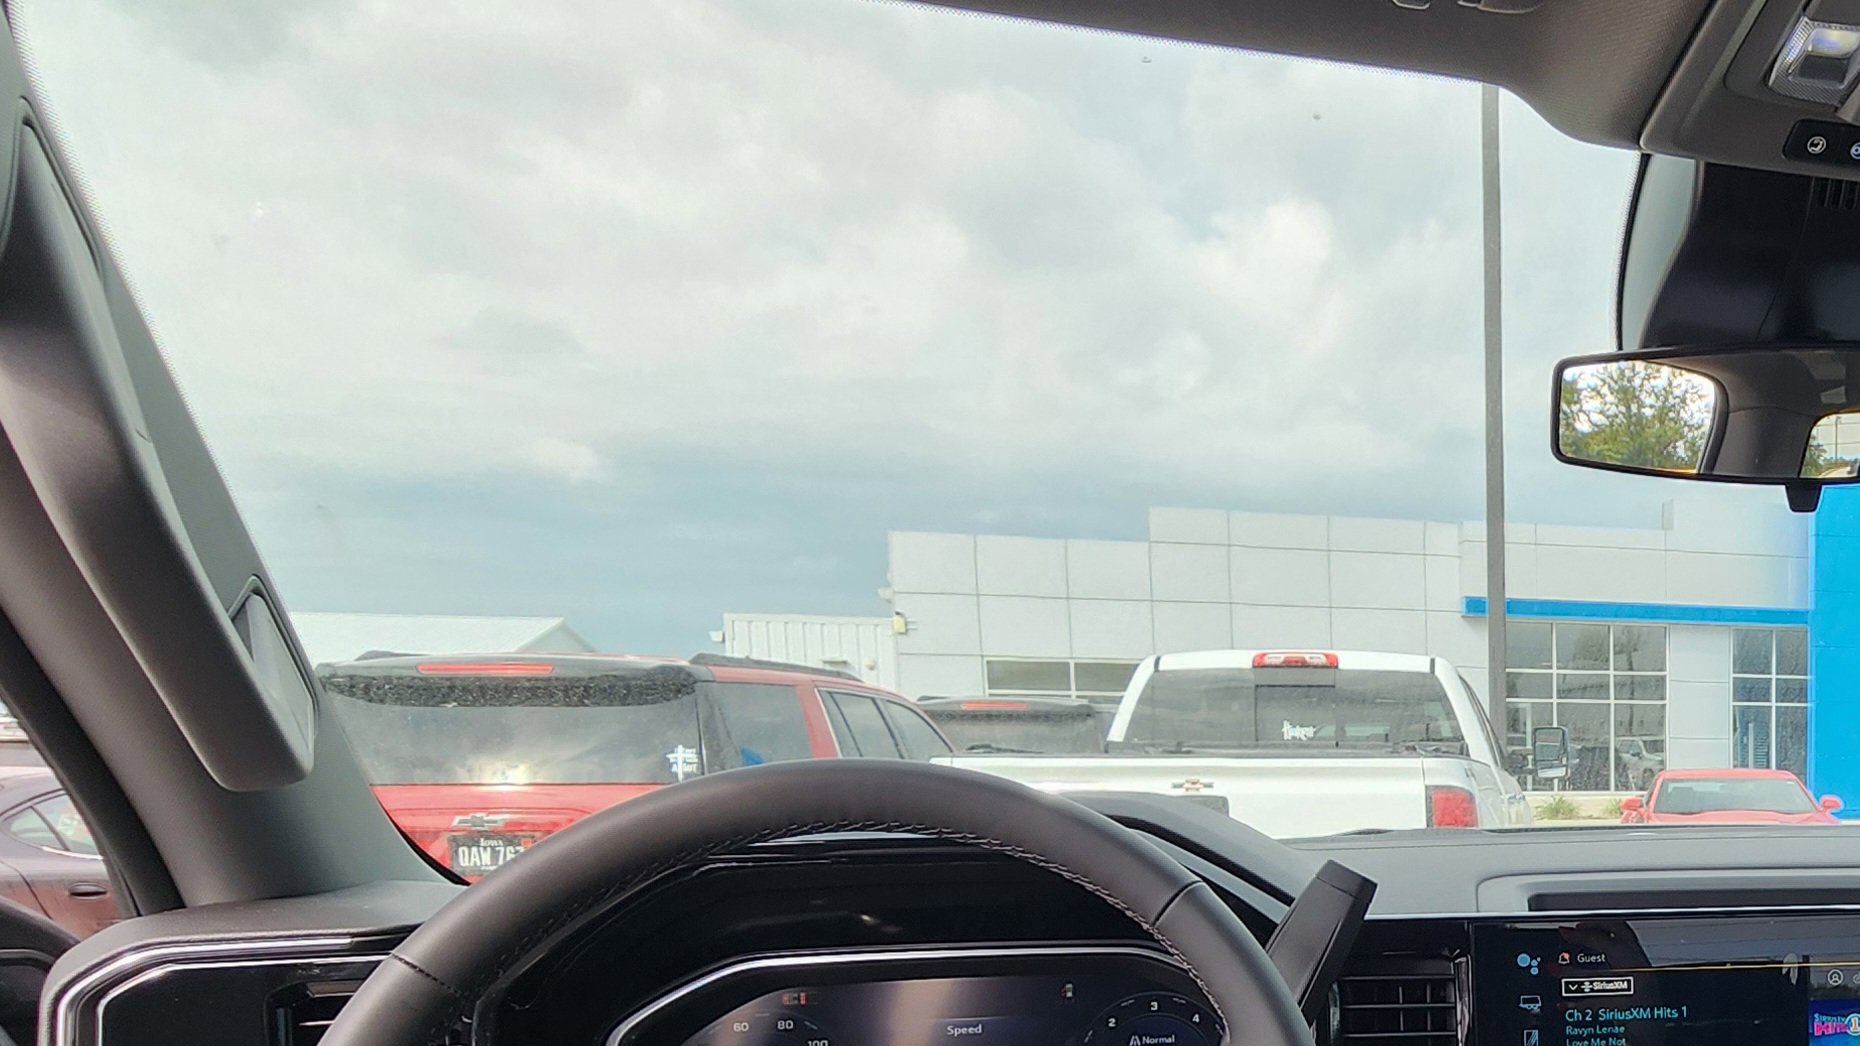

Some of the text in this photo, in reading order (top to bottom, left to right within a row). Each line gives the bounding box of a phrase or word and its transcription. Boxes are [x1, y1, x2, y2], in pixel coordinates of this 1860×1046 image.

[1577, 953, 1606, 963] Guest
[1150, 1001, 1158, 1011] 3
[1192, 1014, 1200, 1023] 4
[1565, 1006, 1687, 1021] Ch 2 SiriusXM Hits 1
[733, 1022, 749, 1032] 60
[777, 1020, 794, 1030] 80
[1108, 1018, 1116, 1027] 2
[946, 1023, 983, 1037] Speed
[1566, 1025, 1625, 1037] Ravyn Lenae
[1142, 1034, 1175, 1044] Normal
[1591, 1038, 1606, 1046] Me
[1609, 1038, 1626, 1046] Not
